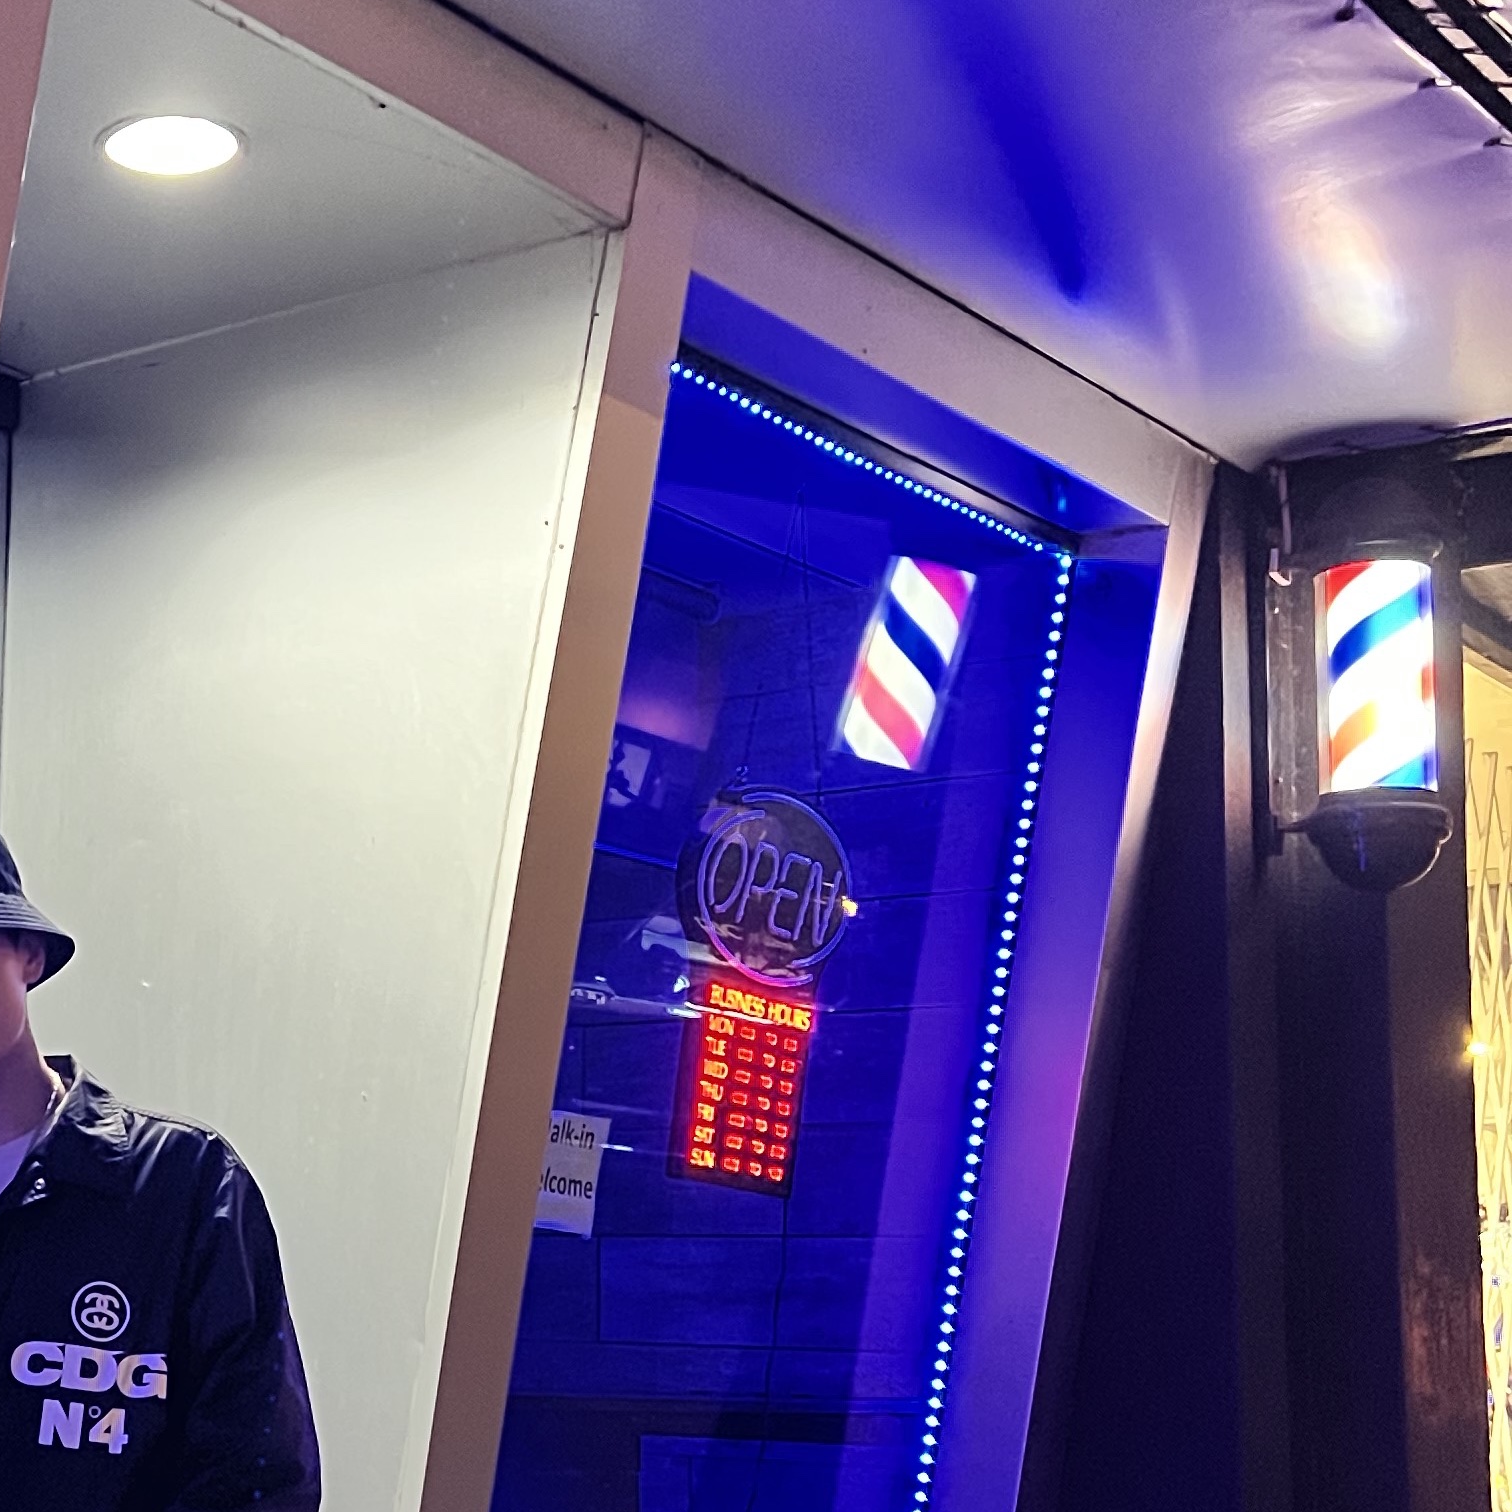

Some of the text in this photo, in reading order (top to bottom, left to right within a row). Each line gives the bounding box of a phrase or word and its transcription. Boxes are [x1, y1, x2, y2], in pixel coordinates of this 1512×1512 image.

[708, 832, 842, 947] OPEN
[709, 1014, 735, 1035] MON
[710, 984, 811, 1031] BUSINESS HOURS
[549, 1118, 595, 1150] alk-in
[539, 1166, 593, 1199] lcome
[10, 1340, 168, 1399] CDG
